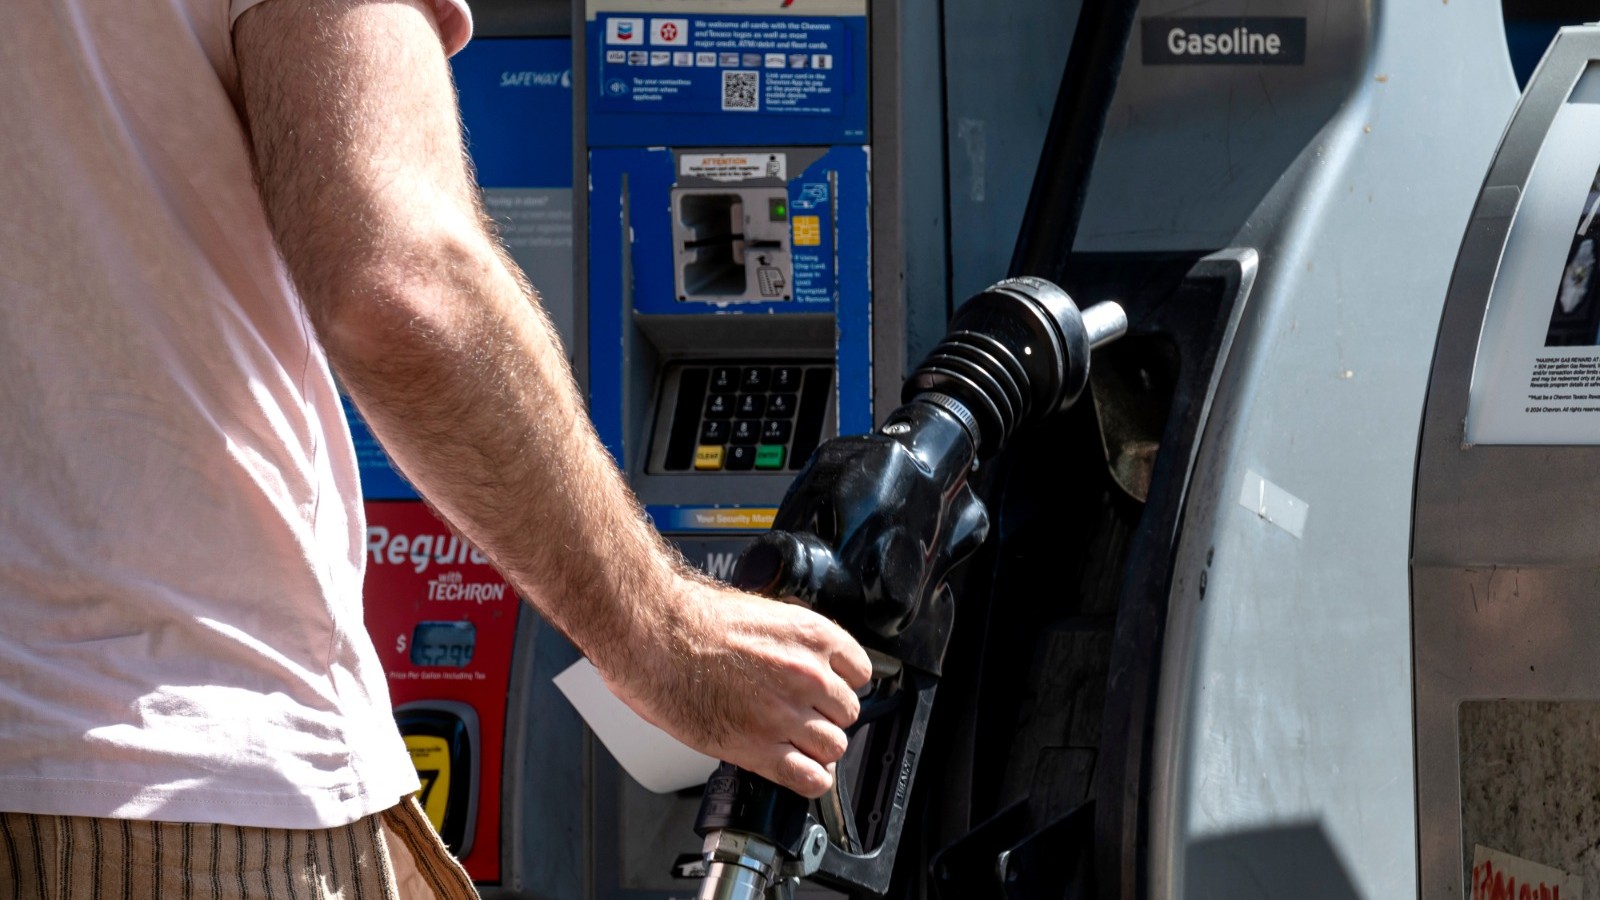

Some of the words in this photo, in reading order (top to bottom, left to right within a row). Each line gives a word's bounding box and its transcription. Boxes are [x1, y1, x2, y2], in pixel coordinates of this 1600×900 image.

[695, 20, 706, 29] We
[708, 21, 739, 29] welcome
[741, 21, 749, 29] all
[751, 22, 769, 30] cards
[771, 22, 786, 30] with
[801, 22, 831, 31] Chevron
[709, 30, 732, 38] Texaco
[733, 31, 752, 40] logos
[694, 41, 714, 50] major
[777, 41, 790, 49] and
[1167, 27, 1281, 55] Gasoline
[500, 71, 560, 87] SAFEWAY
[703, 157, 747, 165] ATTENTION
[800, 254, 818, 263] Using
[796, 287, 827, 295] Prompted
[805, 295, 831, 303] Remove
[721, 370, 726, 379] 1
[751, 370, 757, 380] 2
[781, 369, 788, 380] 3
[715, 396, 722, 405] 4
[746, 395, 752, 405] 5
[776, 397, 782, 406] 6
[711, 421, 718, 431] 7
[741, 422, 748, 432] 8
[771, 421, 778, 431] 9
[735, 447, 743, 458] 0
[696, 514, 714, 523] Your
[716, 514, 751, 524] Security
[707, 553, 737, 580] W
[438, 571, 463, 583] with
[427, 580, 505, 604] TECHRON
[396, 634, 407, 653] $
[390, 671, 406, 680] Price
[408, 671, 419, 680] Per
[421, 671, 441, 680] Gallon
[443, 671, 473, 682] Including
[475, 671, 486, 680] Tax
